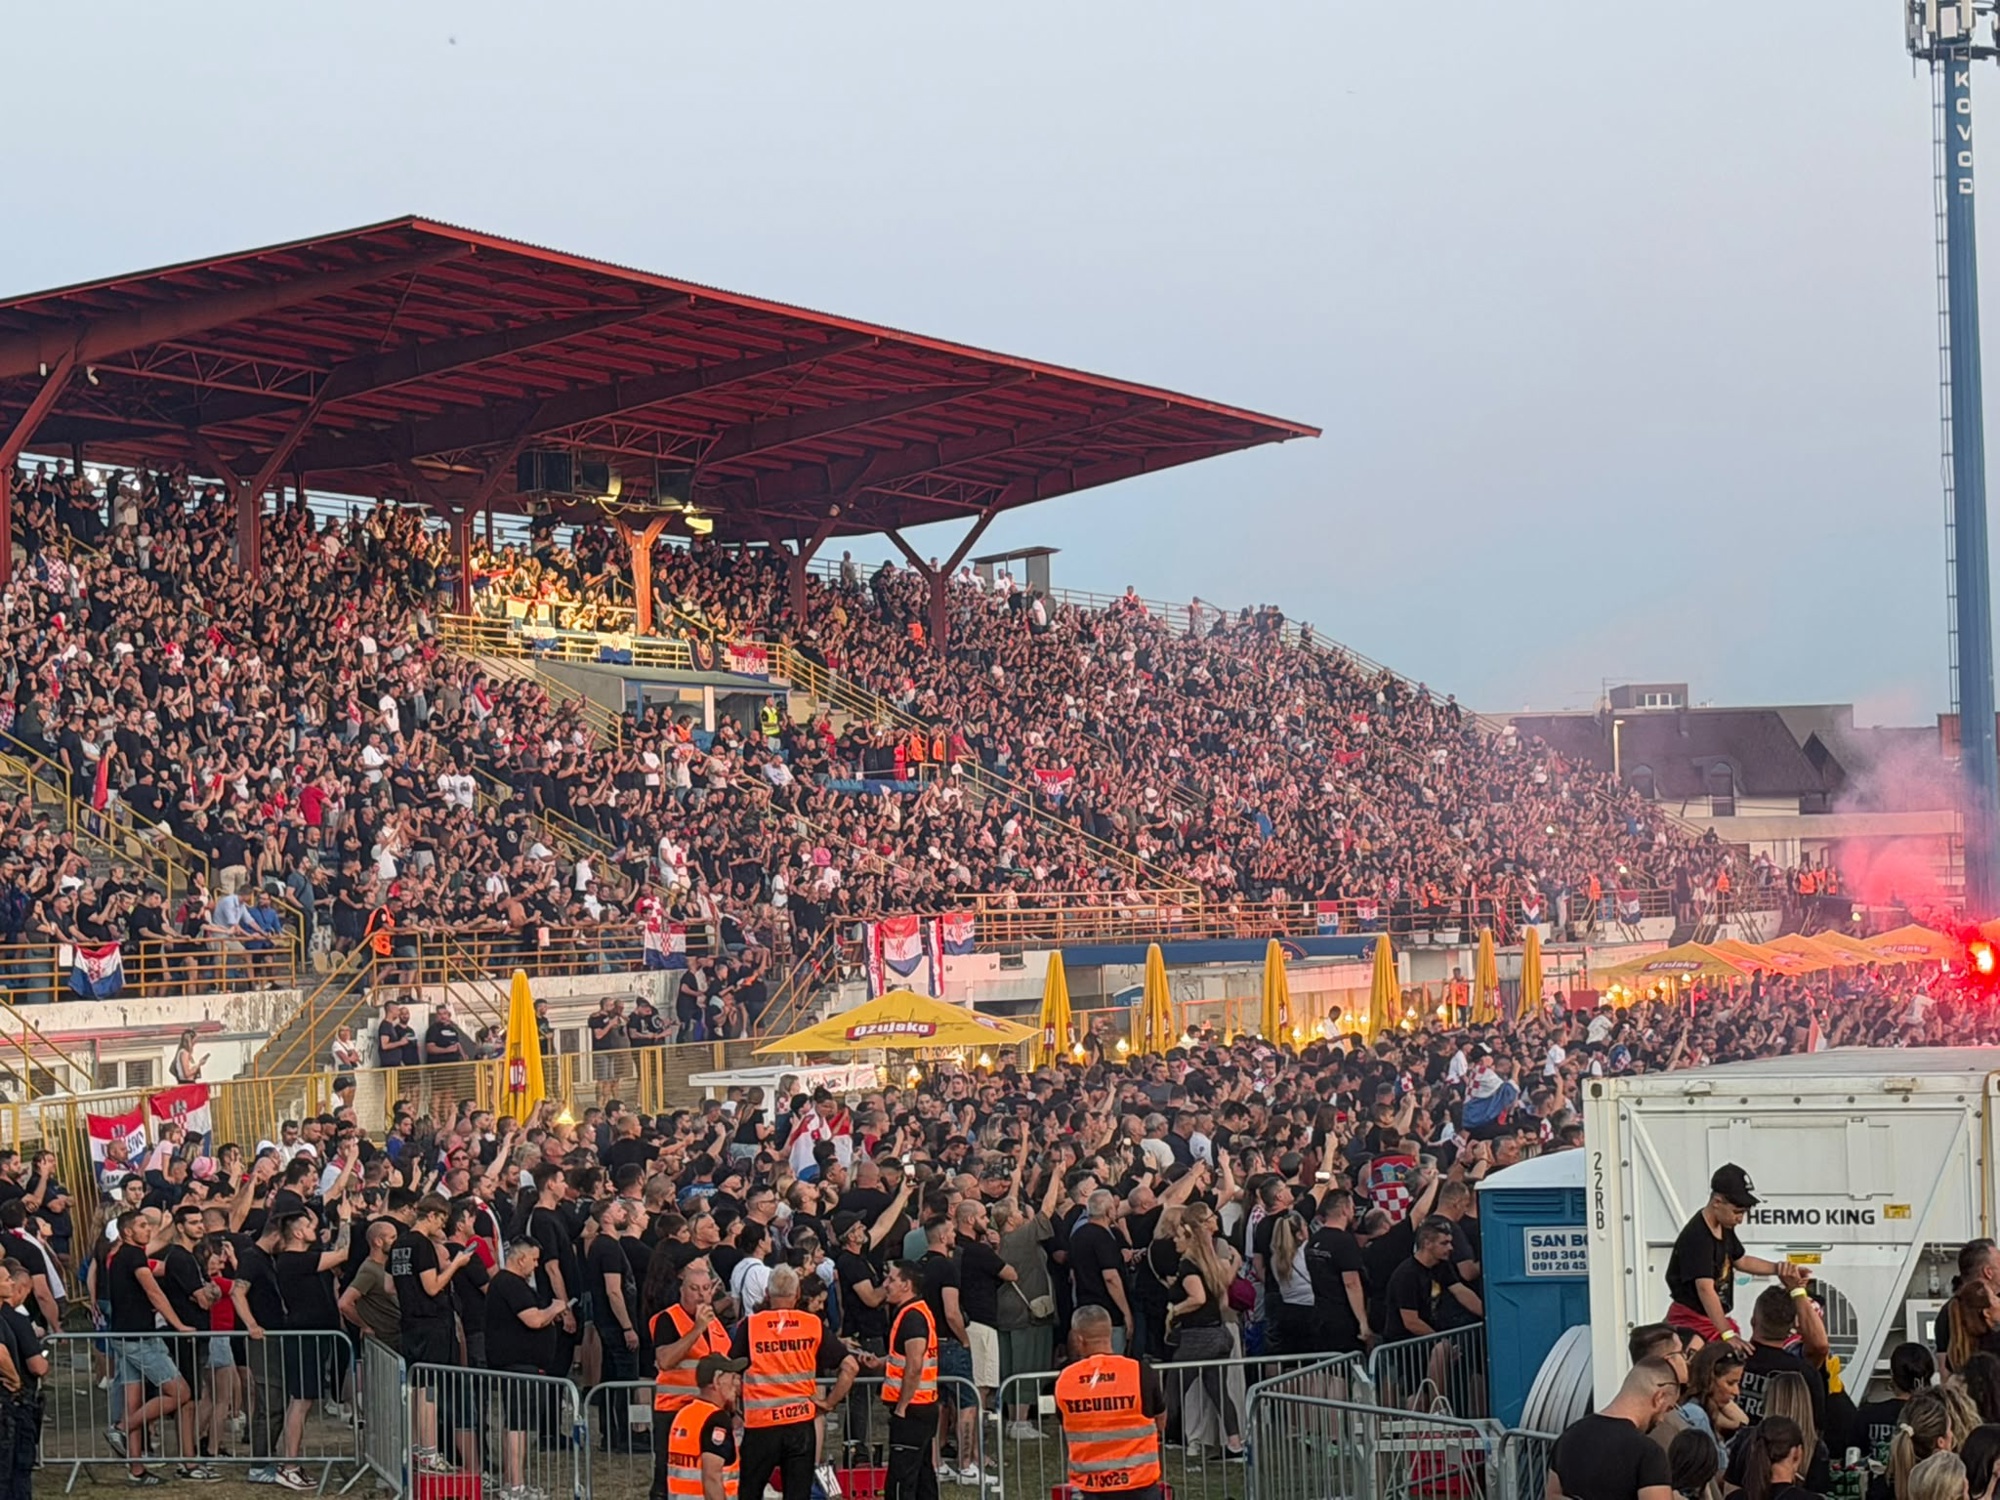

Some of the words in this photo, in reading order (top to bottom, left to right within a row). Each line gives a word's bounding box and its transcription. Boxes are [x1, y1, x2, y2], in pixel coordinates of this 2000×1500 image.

[1954, 56, 1974, 195] KOVOD
[1746, 1209, 1821, 1225] HERMO
[1826, 1209, 1875, 1225] KING
[1530, 1234, 1567, 1248] SAN
[755, 1337, 815, 1354] SECURITY
[1063, 1395, 1135, 1413] SECURITY
